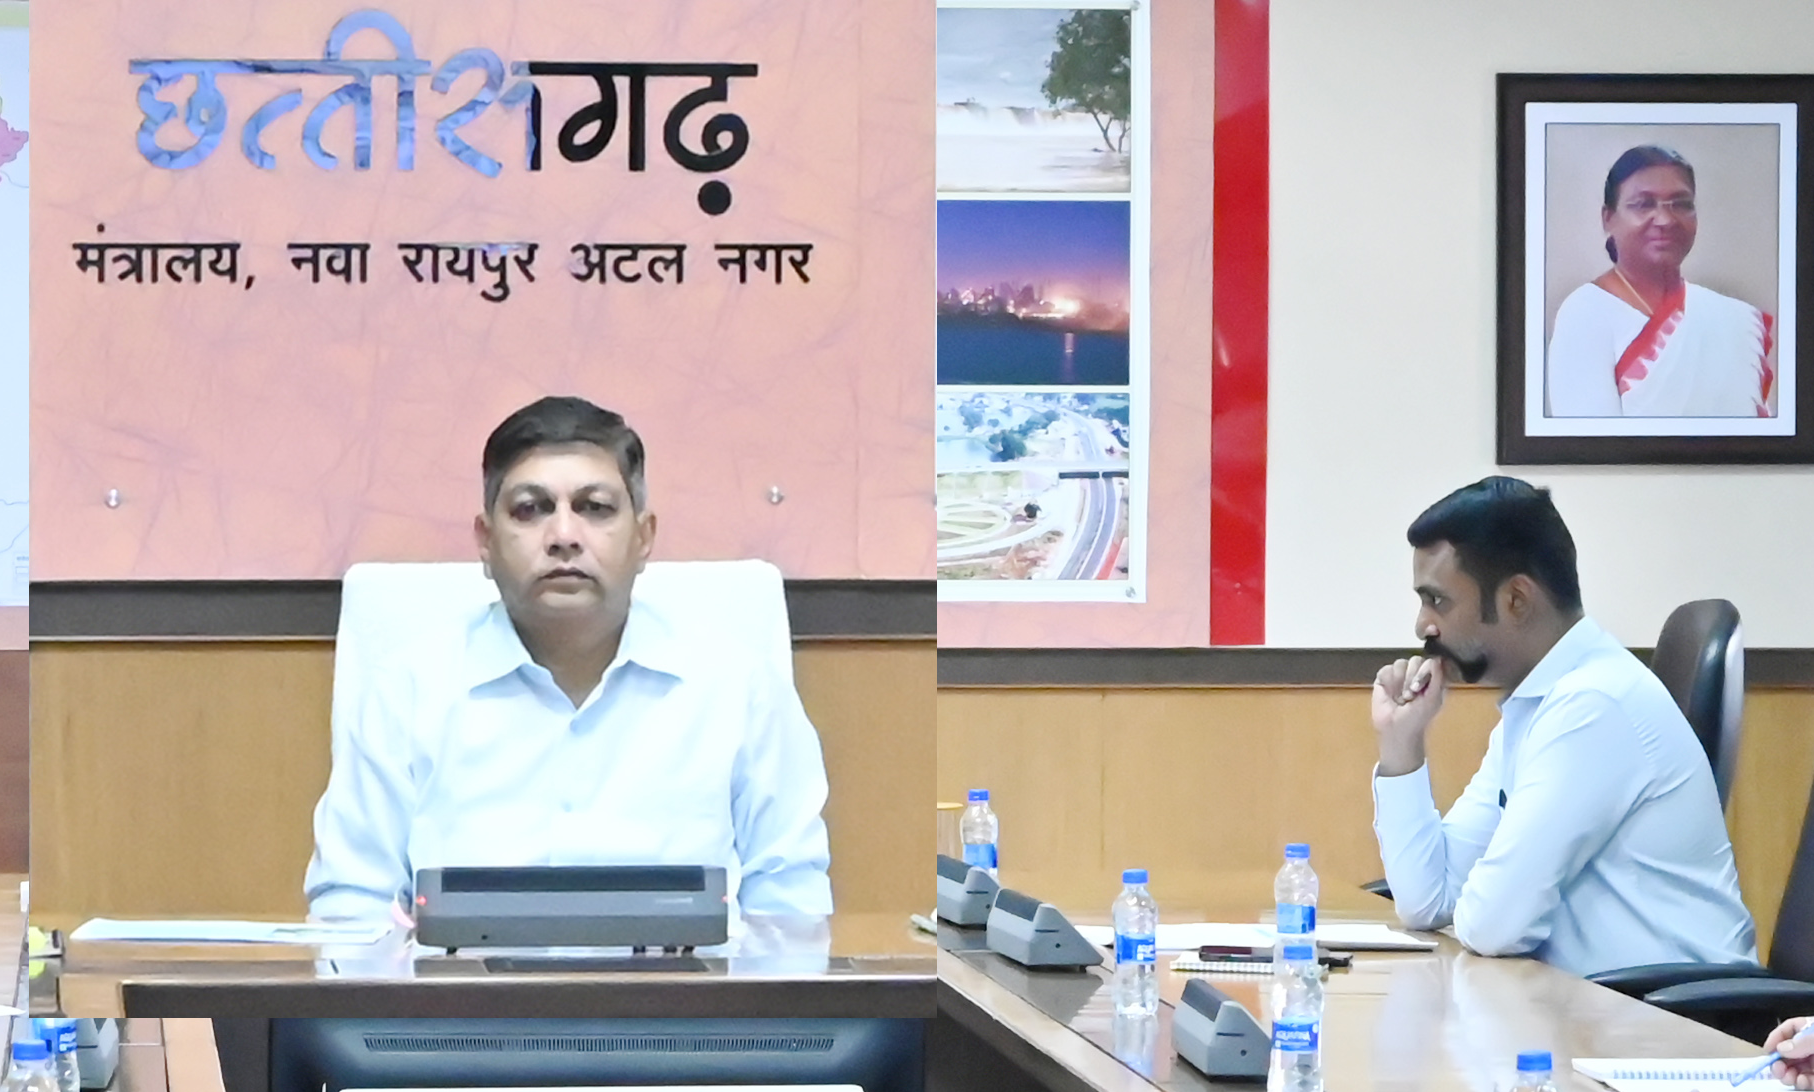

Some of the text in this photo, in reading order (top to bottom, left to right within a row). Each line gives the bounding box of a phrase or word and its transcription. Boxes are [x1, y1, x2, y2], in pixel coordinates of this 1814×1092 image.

[129, 8, 759, 216] छत्तीसगढ़
[73, 224, 813, 302] मंत्रालय, नवा रायपुर अटल नगर
